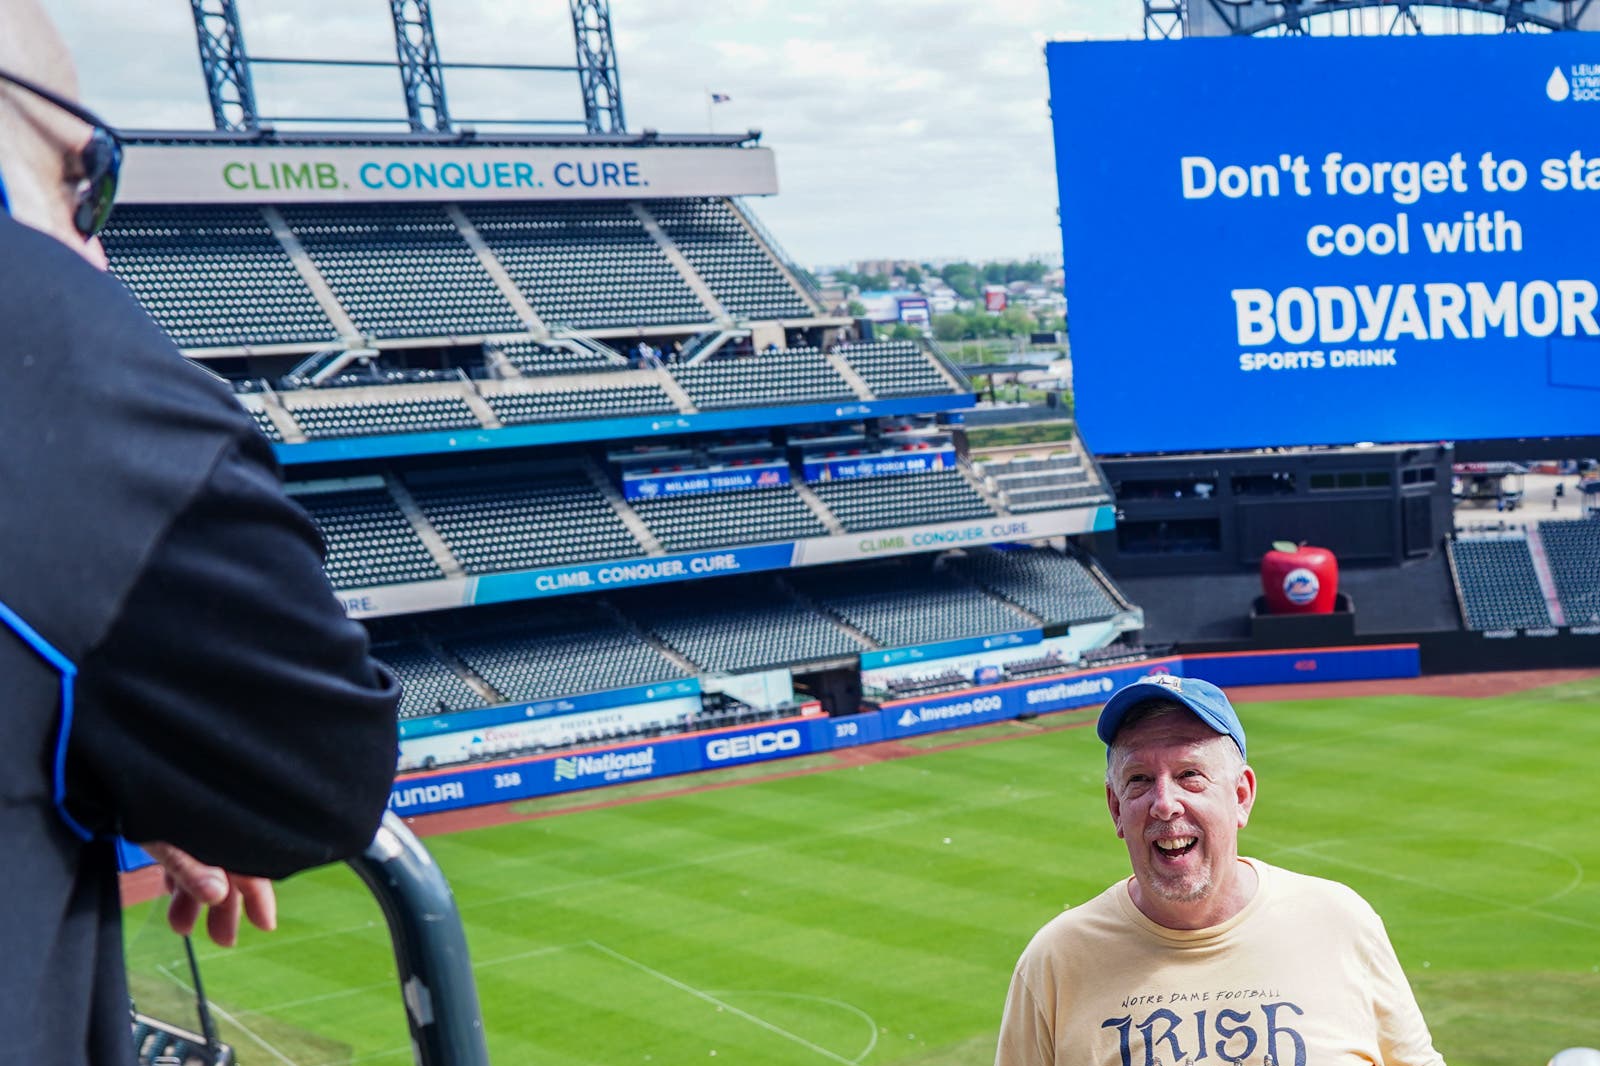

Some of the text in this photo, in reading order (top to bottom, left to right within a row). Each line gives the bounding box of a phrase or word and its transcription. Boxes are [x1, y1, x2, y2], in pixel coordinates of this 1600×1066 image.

[223, 161, 650, 191] CLIMB. CONQUER. CURE.
[1180, 153, 1311, 199] Don't
[1321, 151, 1467, 204] forget
[1479, 152, 1528, 194] to
[1306, 211, 1523, 257] cool with
[1239, 348, 1397, 371] SPORTS DRINK
[860, 522, 1032, 553] CLIMB. CONQUER. CURE.
[536, 553, 741, 592] CLIMB. CONQUER. CURE.
[1026, 678, 1102, 705] smartwater
[920, 700, 973, 722] Invesco
[706, 728, 801, 762] GEICO
[577, 747, 656, 777] National
[388, 782, 464, 808] YUNDAI
[1121, 989, 1281, 1009] NOTRE DAME FOOTBALL
